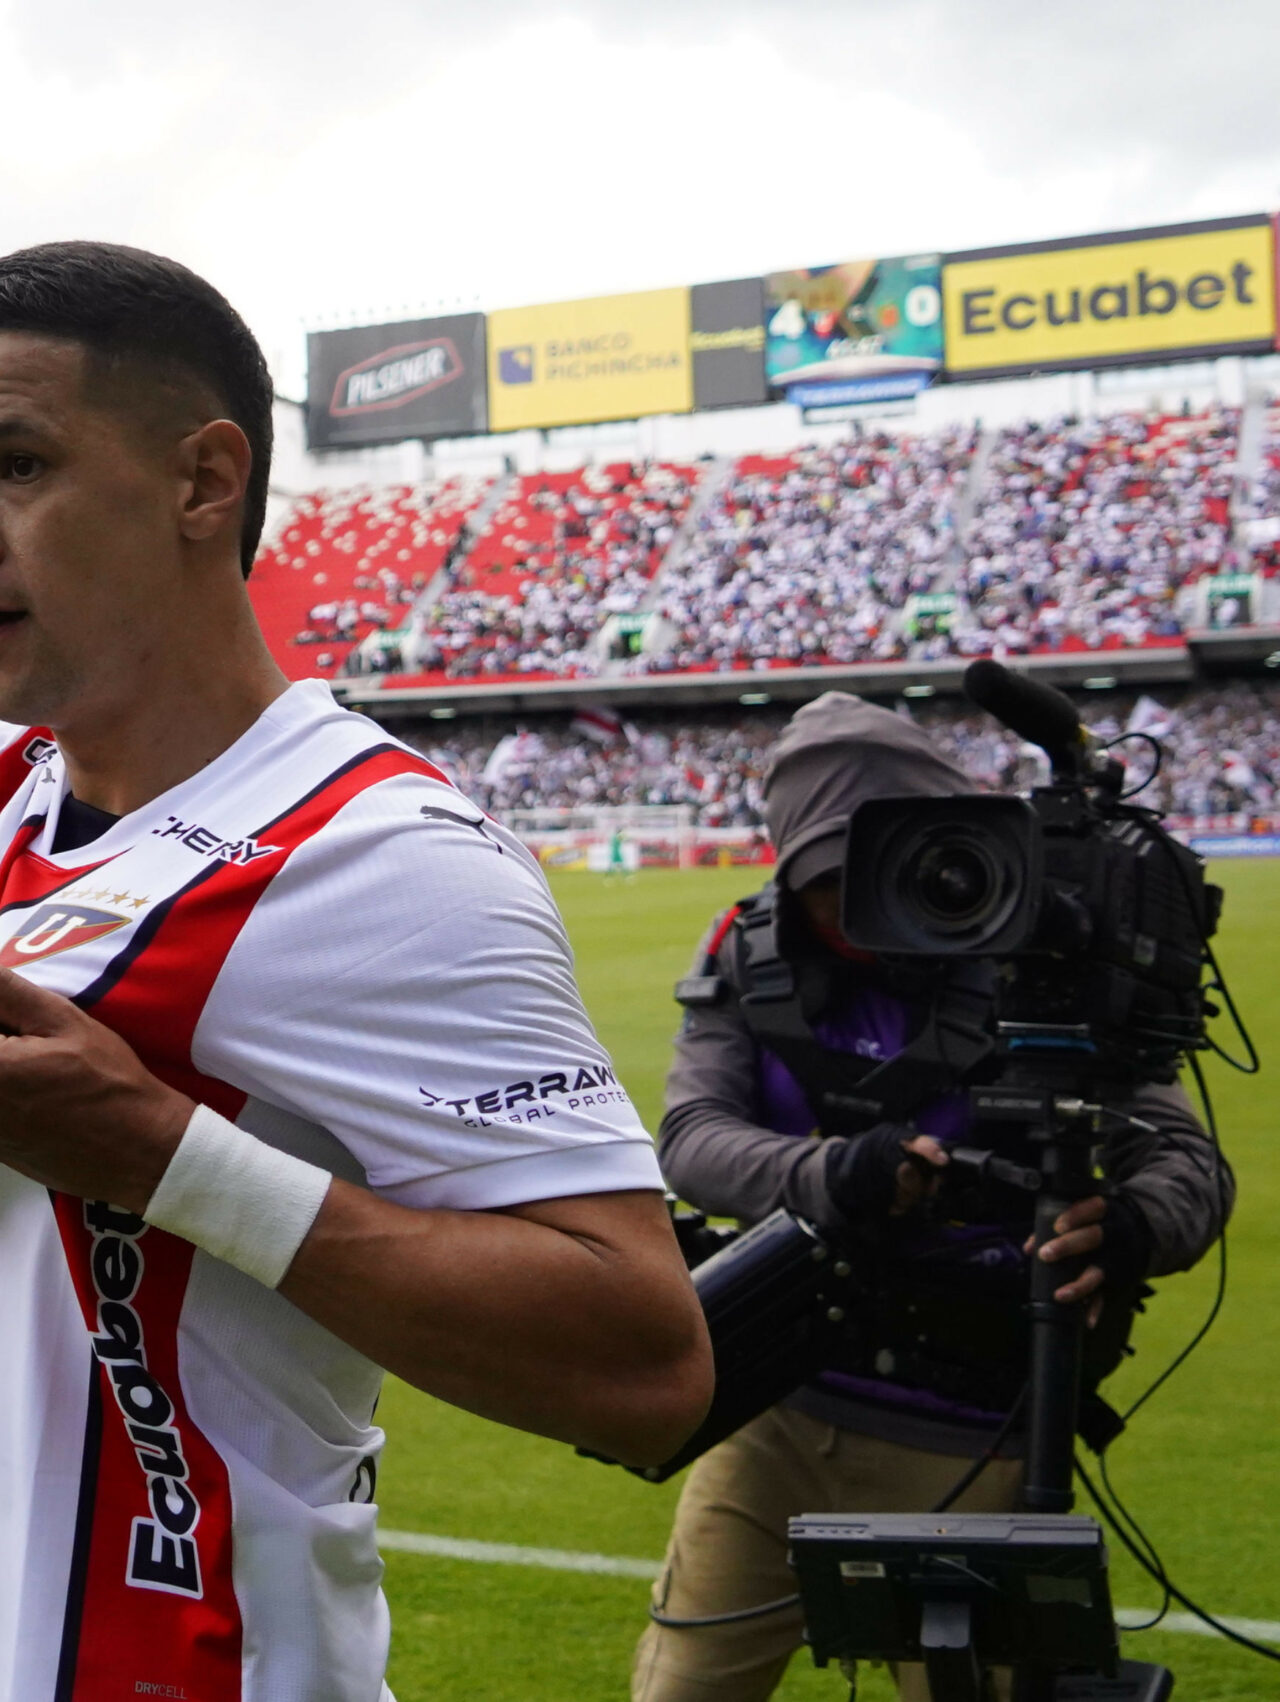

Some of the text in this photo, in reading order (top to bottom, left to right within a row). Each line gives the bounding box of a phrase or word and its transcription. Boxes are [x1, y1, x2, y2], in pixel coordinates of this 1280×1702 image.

[904, 284, 942, 327] 0
[960, 259, 1254, 336] Ecuabet
[769, 299, 807, 341] 4
[545, 332, 632, 359] BANCO
[545, 351, 683, 381] PICHINCHA
[346, 345, 448, 408] PILSENER
[152, 816, 276, 864] HERY
[464, 1105, 556, 1128] GLOBAL
[84, 1200, 202, 1596] Ecuabet
[135, 1680, 189, 1700] DRYCELL
